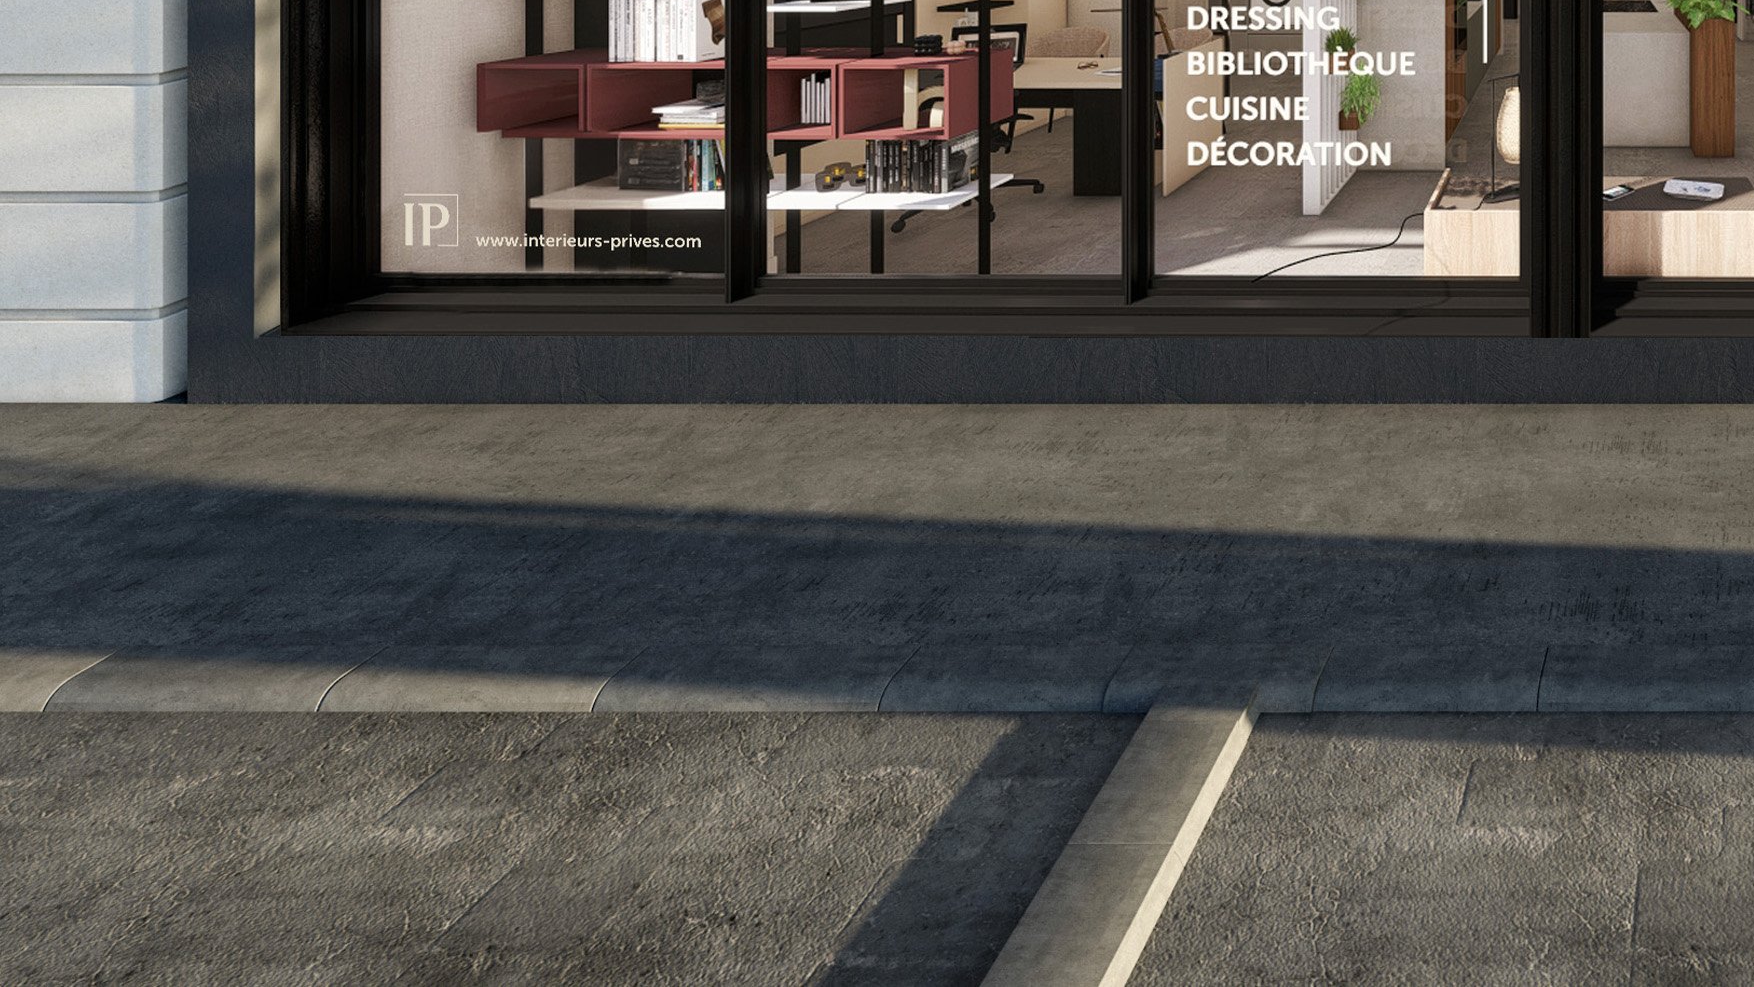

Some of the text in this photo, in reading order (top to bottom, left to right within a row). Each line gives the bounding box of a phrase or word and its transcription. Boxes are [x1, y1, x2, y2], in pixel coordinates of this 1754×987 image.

[1187, 6, 1340, 31] DRESSING
[1187, 46, 1416, 77] BIBLIOTHÈQUE
[1186, 96, 1310, 121] CUISINE
[1187, 136, 1392, 167] DÉCORATION
[403, 203, 450, 246] IP
[475, 233, 702, 252] www.interieurs-prives.com
